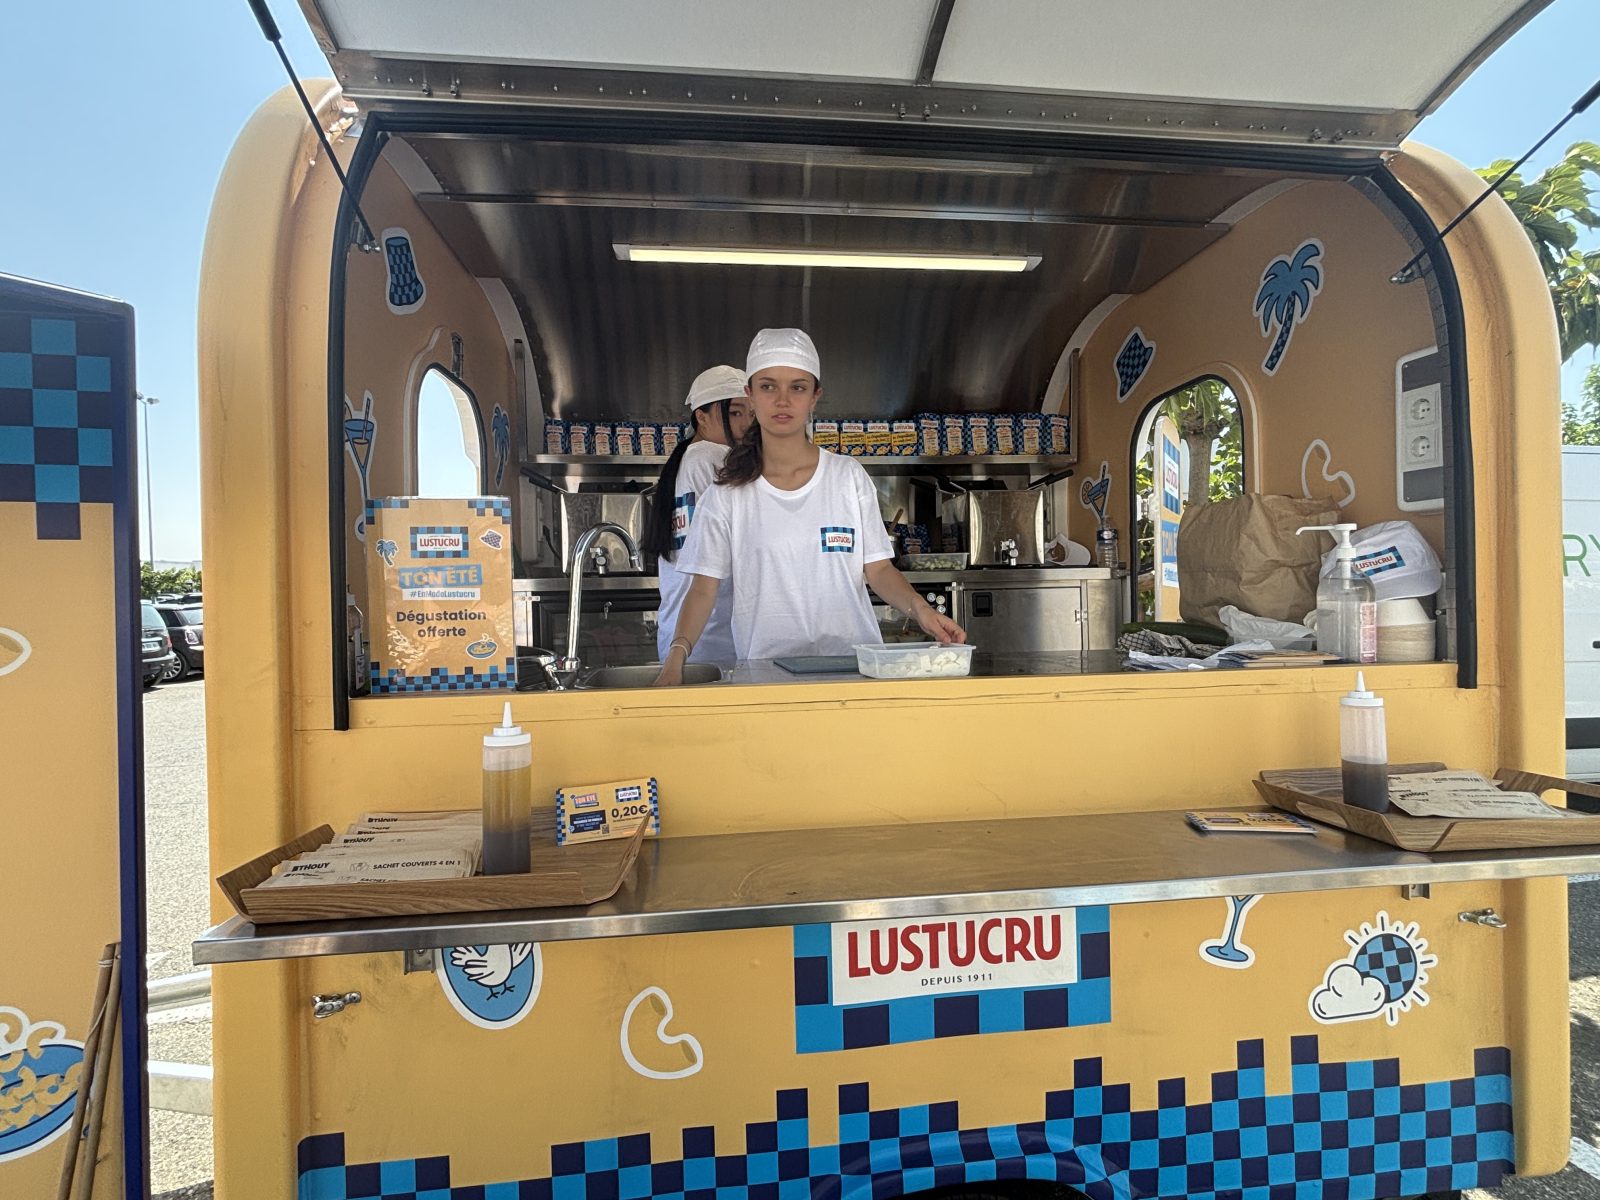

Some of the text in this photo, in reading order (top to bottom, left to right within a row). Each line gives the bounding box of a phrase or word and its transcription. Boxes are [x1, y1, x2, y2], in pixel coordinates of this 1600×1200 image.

[419, 538, 460, 547] LUSTUCRU
[1355, 555, 1393, 570] LUSTUCRU
[400, 566, 478, 586] TON ÉTÉ
[396, 608, 486, 625] Dégustation
[417, 626, 466, 638] offerte
[611, 805, 648, 819] 0,20€
[847, 914, 1062, 979] LUSTUCRU
[921, 972, 993, 987] DEPUIS 1911
